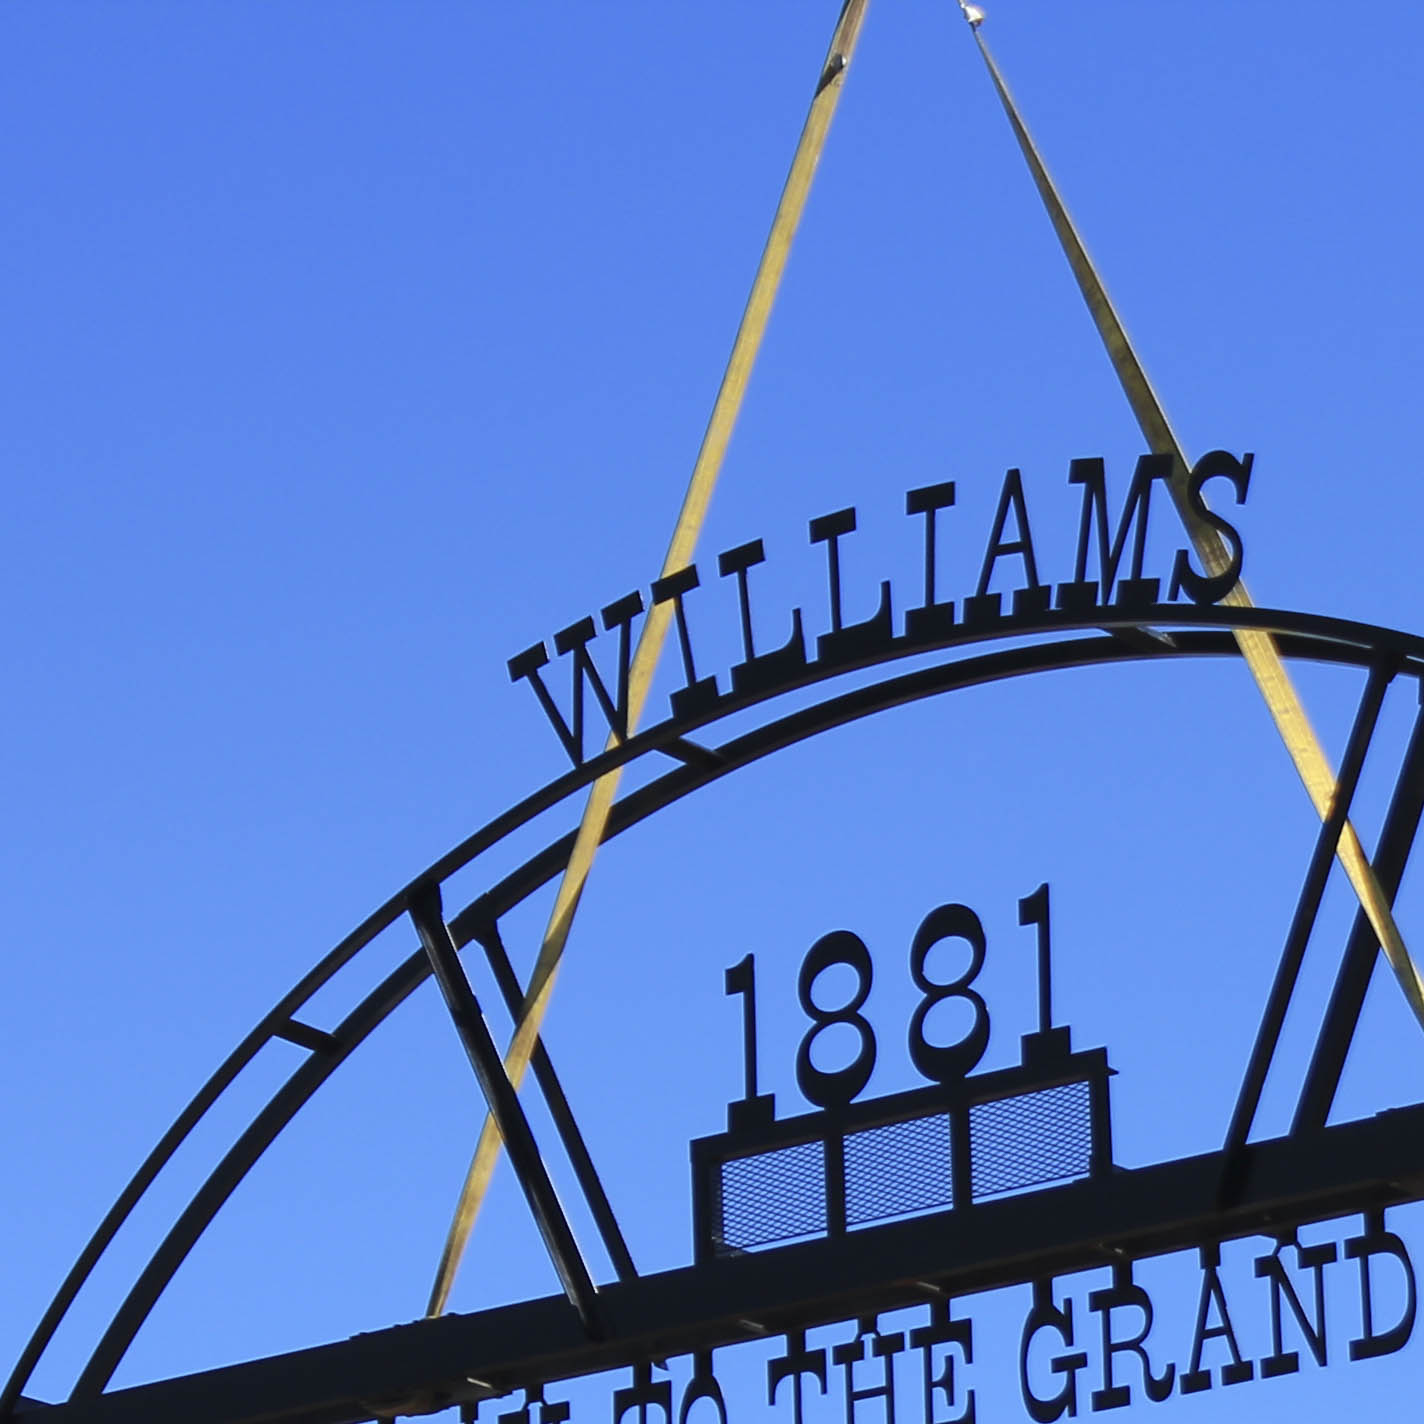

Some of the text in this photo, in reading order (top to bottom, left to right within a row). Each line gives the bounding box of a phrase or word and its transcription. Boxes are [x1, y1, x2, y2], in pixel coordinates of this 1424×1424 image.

[507, 450, 1256, 768] WILLIAMS
[724, 882, 1071, 1134] 1881
[1019, 1227, 1418, 1424] GRAND
